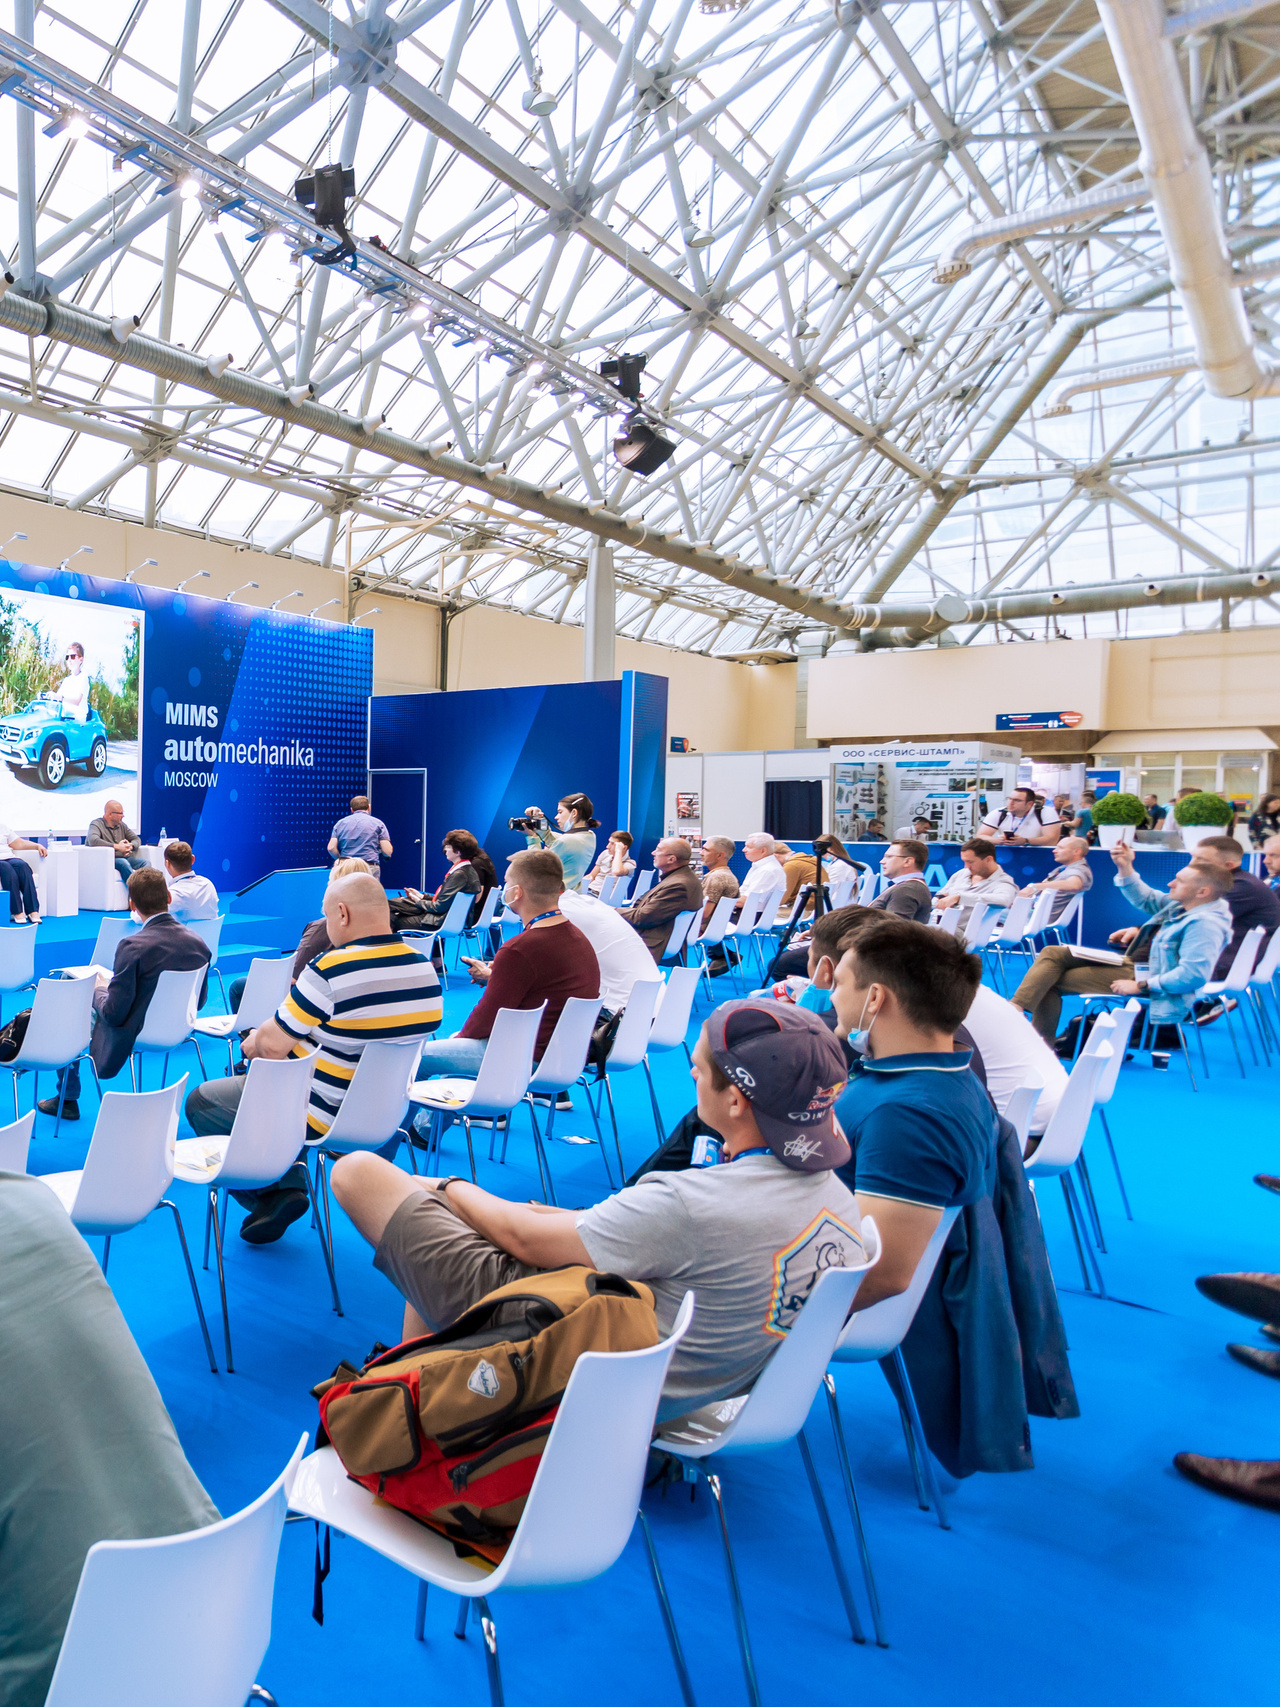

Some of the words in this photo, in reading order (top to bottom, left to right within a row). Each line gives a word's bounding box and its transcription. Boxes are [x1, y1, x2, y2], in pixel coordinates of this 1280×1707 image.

[165, 702, 218, 728] MIMS
[164, 735, 314, 766] automechanika
[842, 750, 866, 758] ООО
[868, 748, 965, 757] «СЕРВИС-ШТАМП»
[164, 771, 218, 787] MOSCOW
